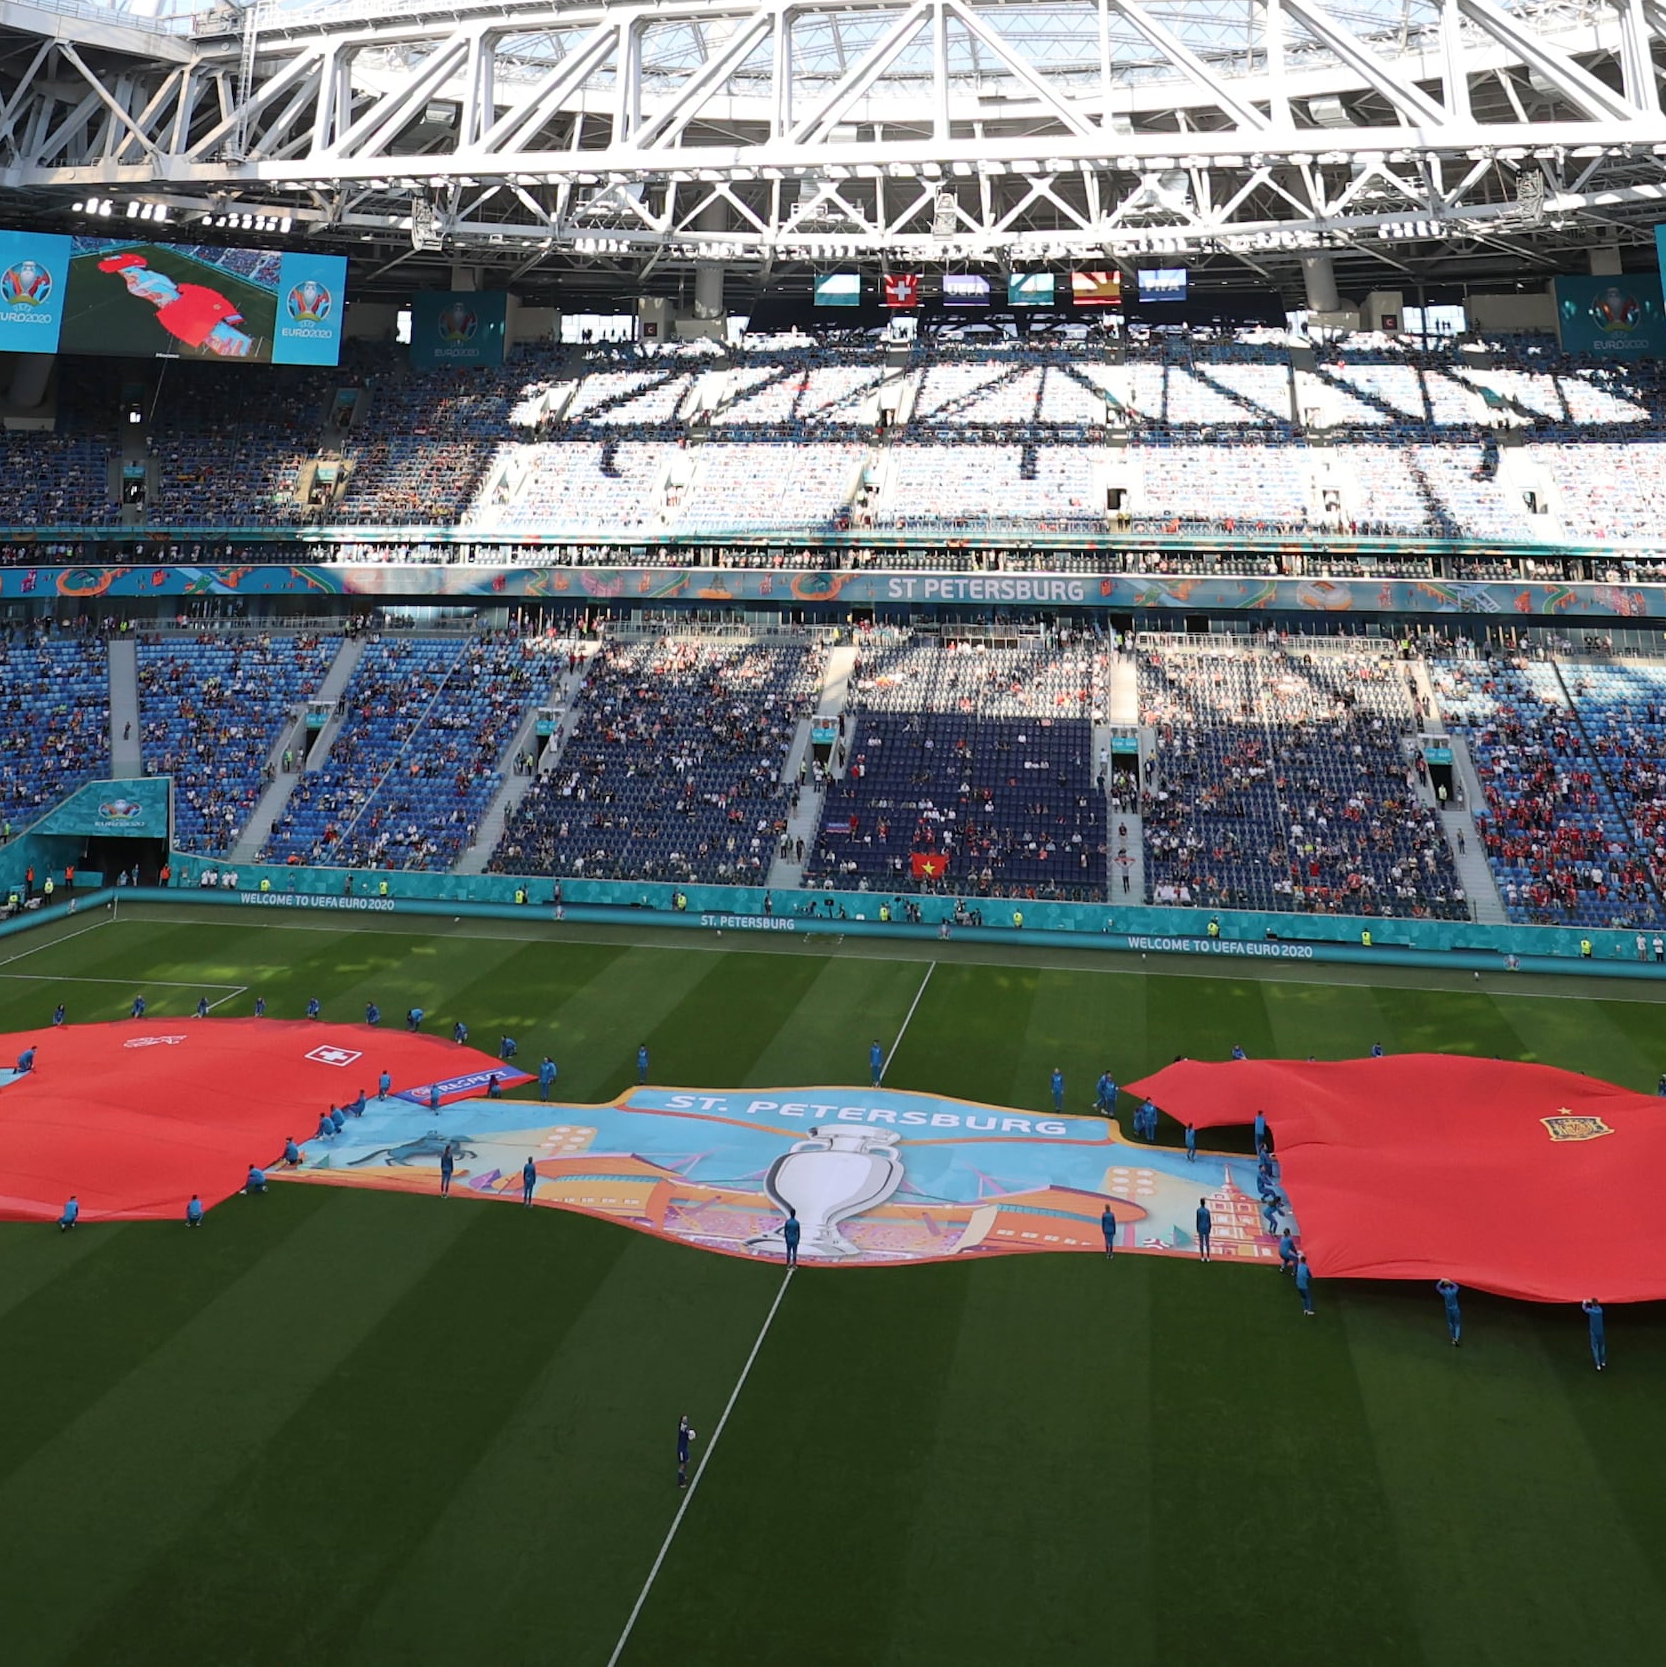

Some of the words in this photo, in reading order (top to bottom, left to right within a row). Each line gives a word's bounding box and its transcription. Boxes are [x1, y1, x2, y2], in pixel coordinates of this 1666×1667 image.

[947, 283, 984, 296] UEFA
[1144, 278, 1180, 292] FIFA
[281, 327, 333, 339] EURO2020
[888, 578, 917, 598] ST
[925, 579, 1084, 601] PETERSBURG
[241, 893, 292, 905] WELCOME
[295, 895, 309, 907] TO
[311, 896, 338, 908] UEFA
[338, 898, 367, 909] EURO
[368, 899, 395, 911] 2020
[700, 915, 717, 927] ST.
[720, 916, 795, 930] PETERSBURG
[665, 1095, 728, 1112] ST.
[746, 1100, 1067, 1135] PETERSBURG
